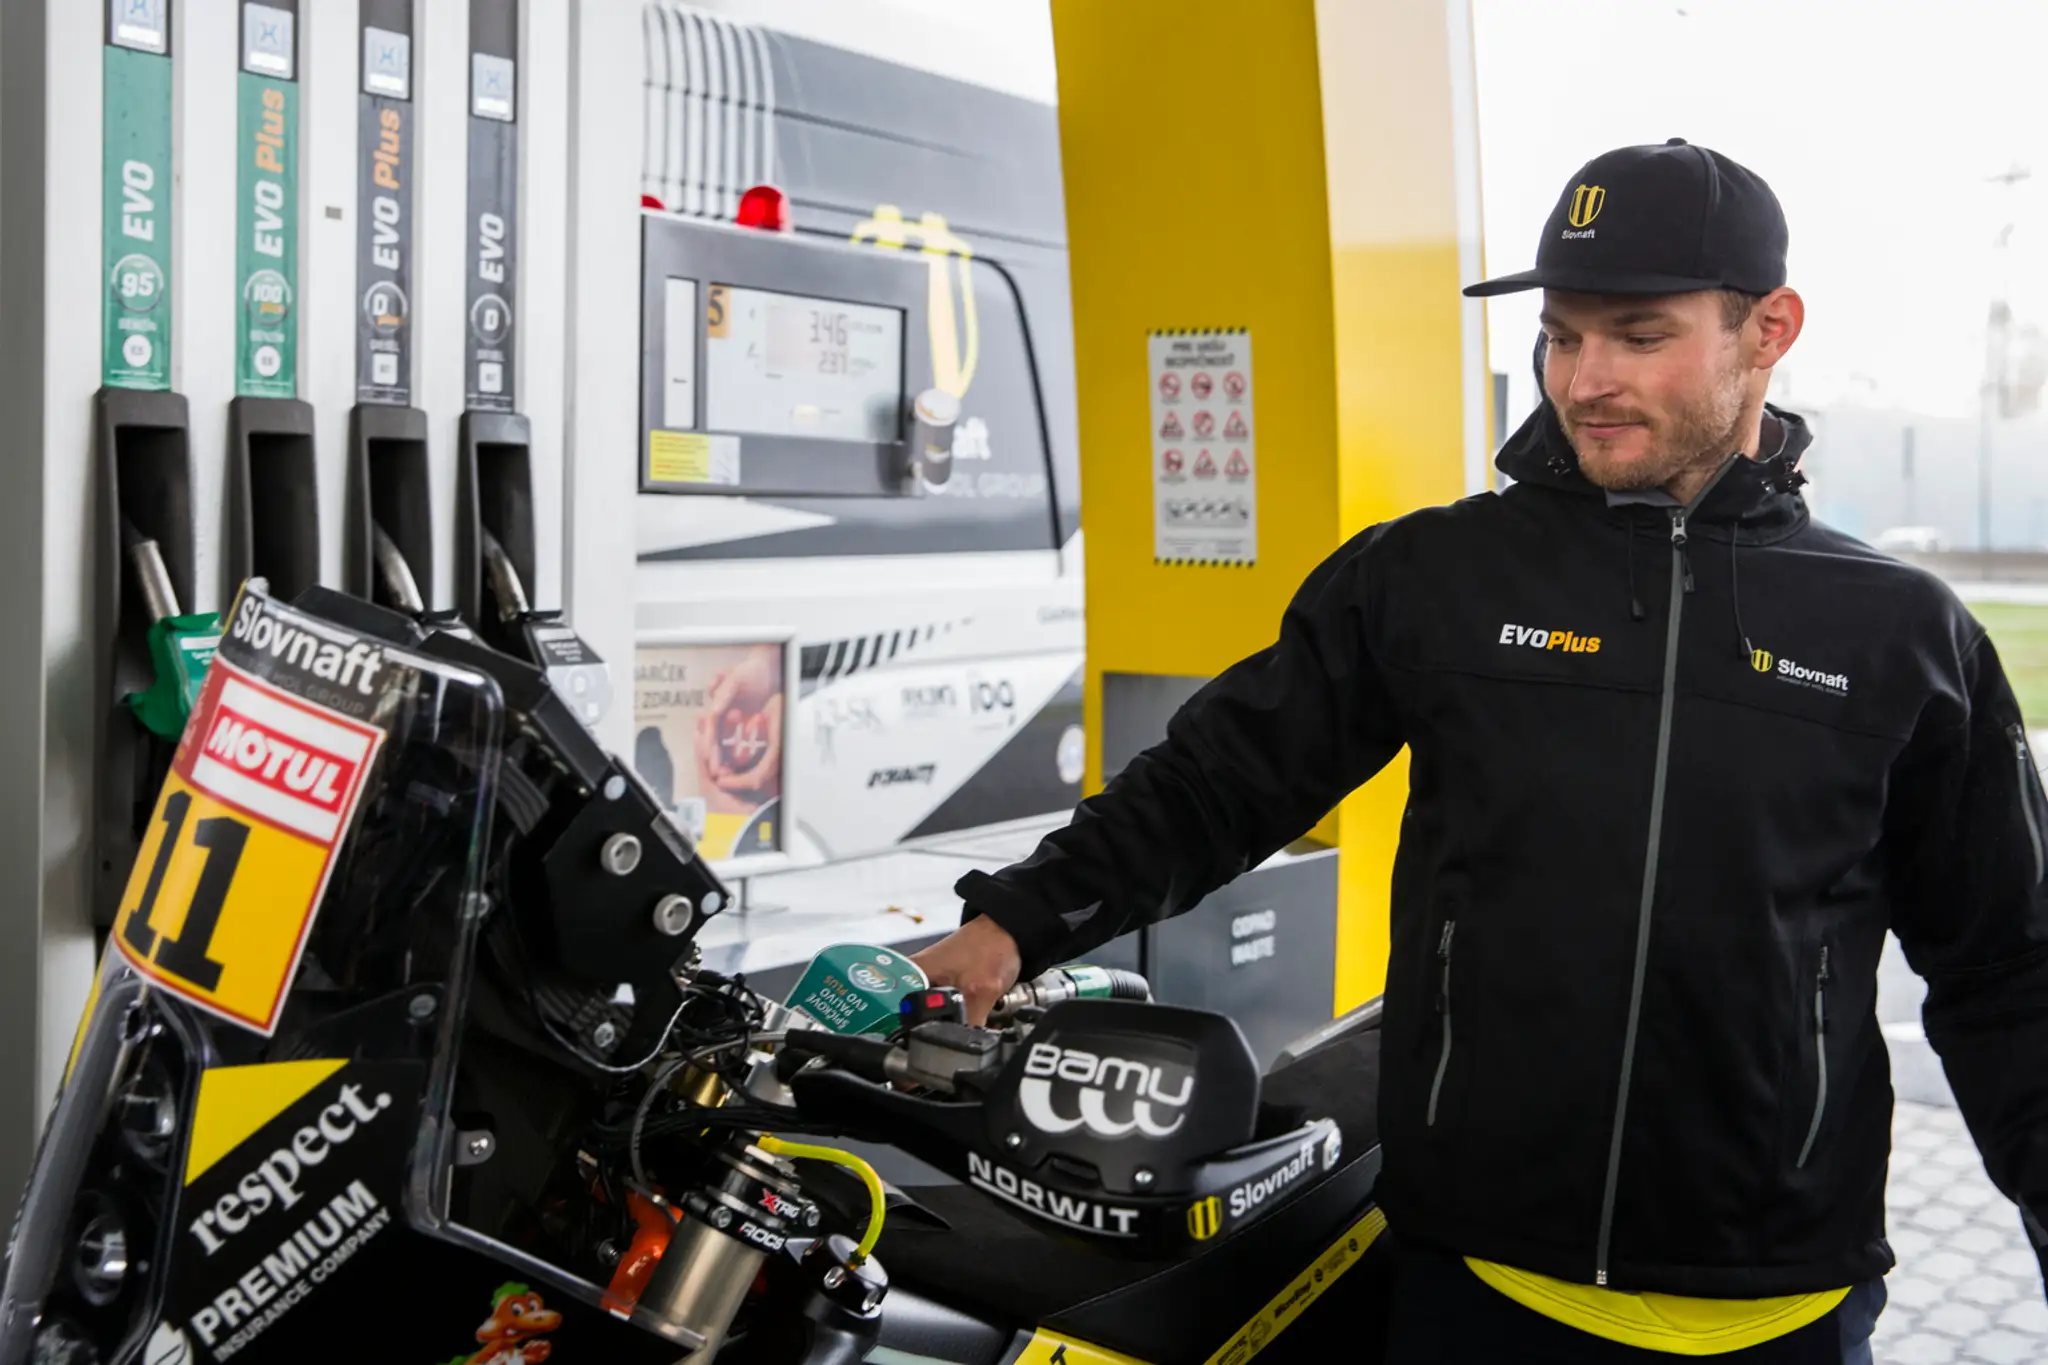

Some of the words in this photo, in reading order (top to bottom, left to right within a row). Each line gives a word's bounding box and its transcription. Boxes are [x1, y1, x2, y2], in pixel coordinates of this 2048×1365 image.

[255, 88, 285, 174] Plus
[373, 107, 401, 189] Plus
[122, 159, 155, 242] EVO
[254, 180, 285, 258] EVO
[372, 196, 400, 270] EVO
[1561, 228, 1596, 240] Slovnaft
[121, 272, 154, 297] 95
[479, 212, 504, 284] EVO
[232, 597, 382, 695] Slovnaft
[1499, 623, 1601, 653] EVOPlus
[1777, 658, 1849, 691] Slovnaft
[207, 716, 341, 801] MOTUL
[122, 789, 250, 993] 11
[820, 988, 855, 1017] PALIVO
[823, 975, 849, 996] PLUS
[846, 993, 869, 1012] EVO
[188, 1082, 393, 1258] respect.
[968, 1150, 1139, 1234] NORWIT
[1229, 1142, 1317, 1218] Slovnaft
[191, 1178, 379, 1347] PREMIUM
[212, 1280, 312, 1364] INSURANCE
[311, 1207, 393, 1286] COMPANY
